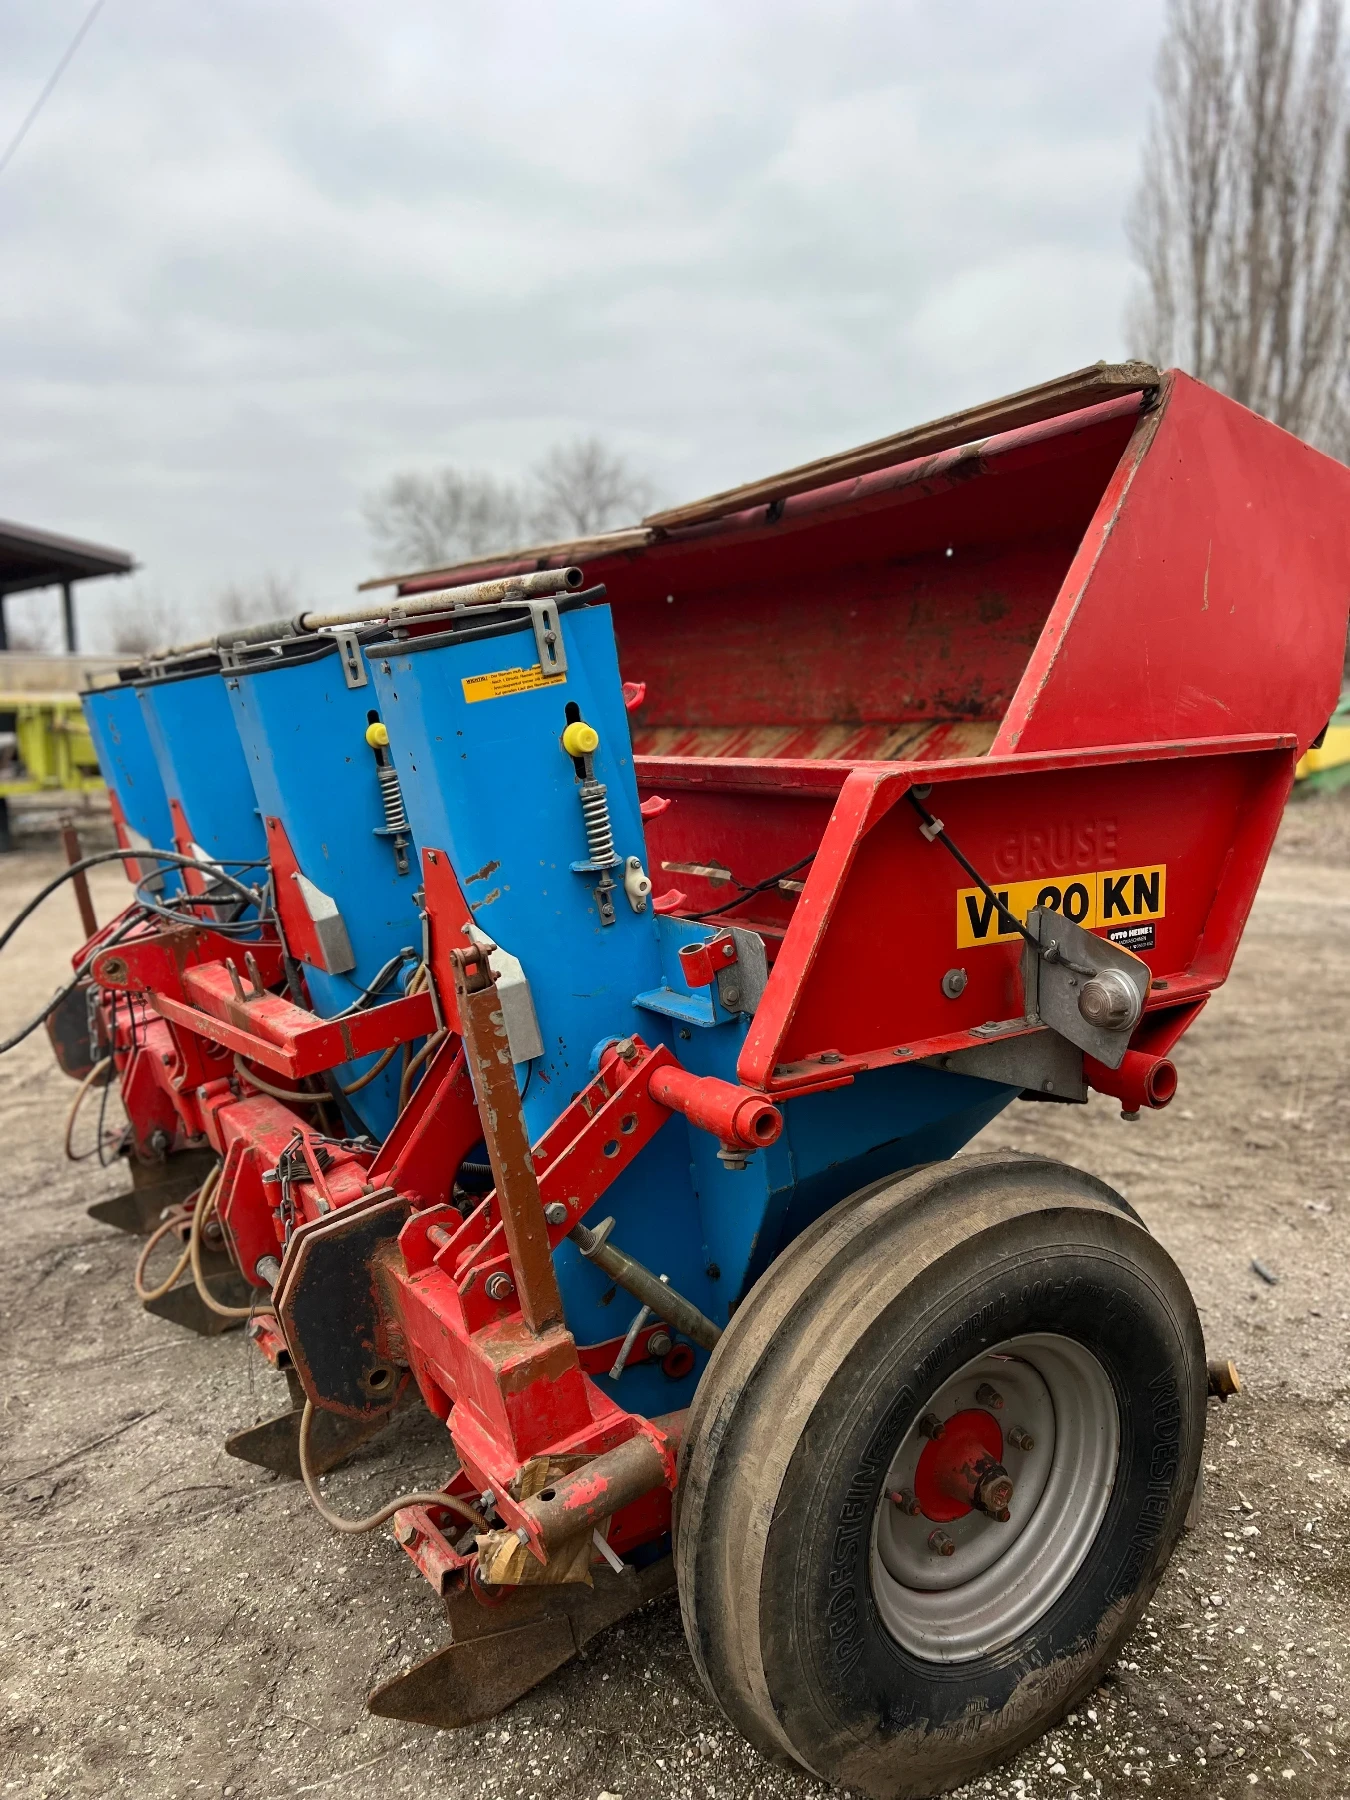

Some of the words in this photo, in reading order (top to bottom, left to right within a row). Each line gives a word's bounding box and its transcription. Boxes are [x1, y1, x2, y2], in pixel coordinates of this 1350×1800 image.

[993, 816, 1118, 877] GRUSE
[1103, 872, 1159, 919] KN
[1110, 931, 1128, 941] OTTO
[1129, 1361, 1181, 1551] VREDESTEIN
[828, 1460, 877, 1679] VREDESTEIN
